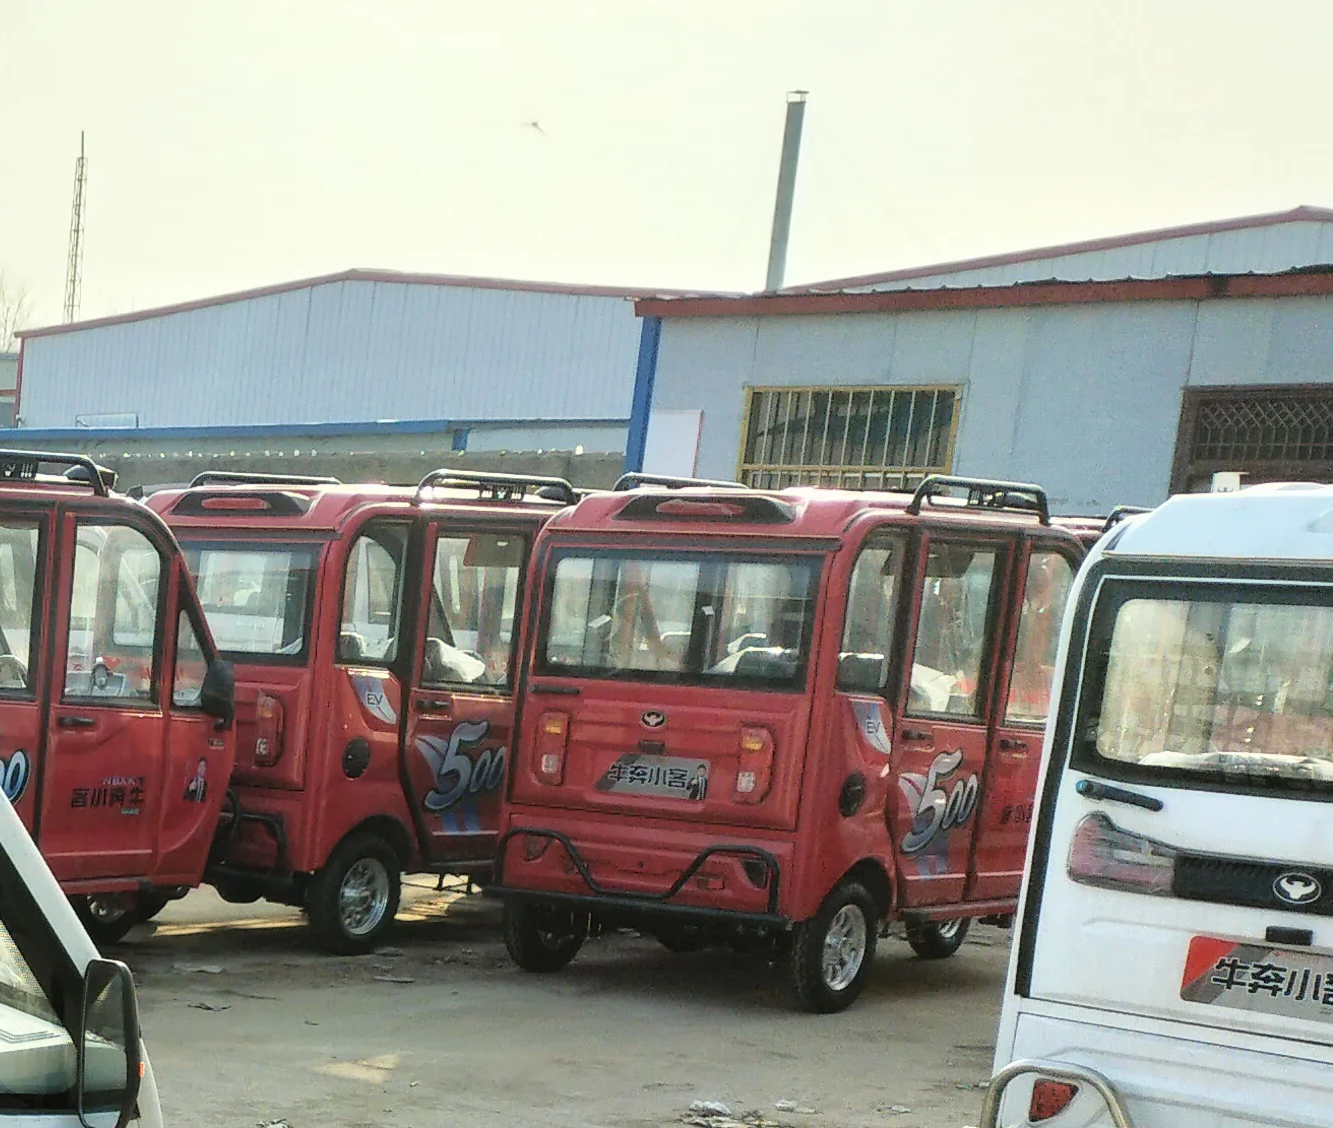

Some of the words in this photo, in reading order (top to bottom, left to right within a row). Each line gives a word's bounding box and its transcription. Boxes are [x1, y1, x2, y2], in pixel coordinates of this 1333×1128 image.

[367, 693, 384, 706] EV
[423, 720, 508, 812] 500
[606, 763, 689, 789] 牛奔小客
[900, 748, 979, 854] 500
